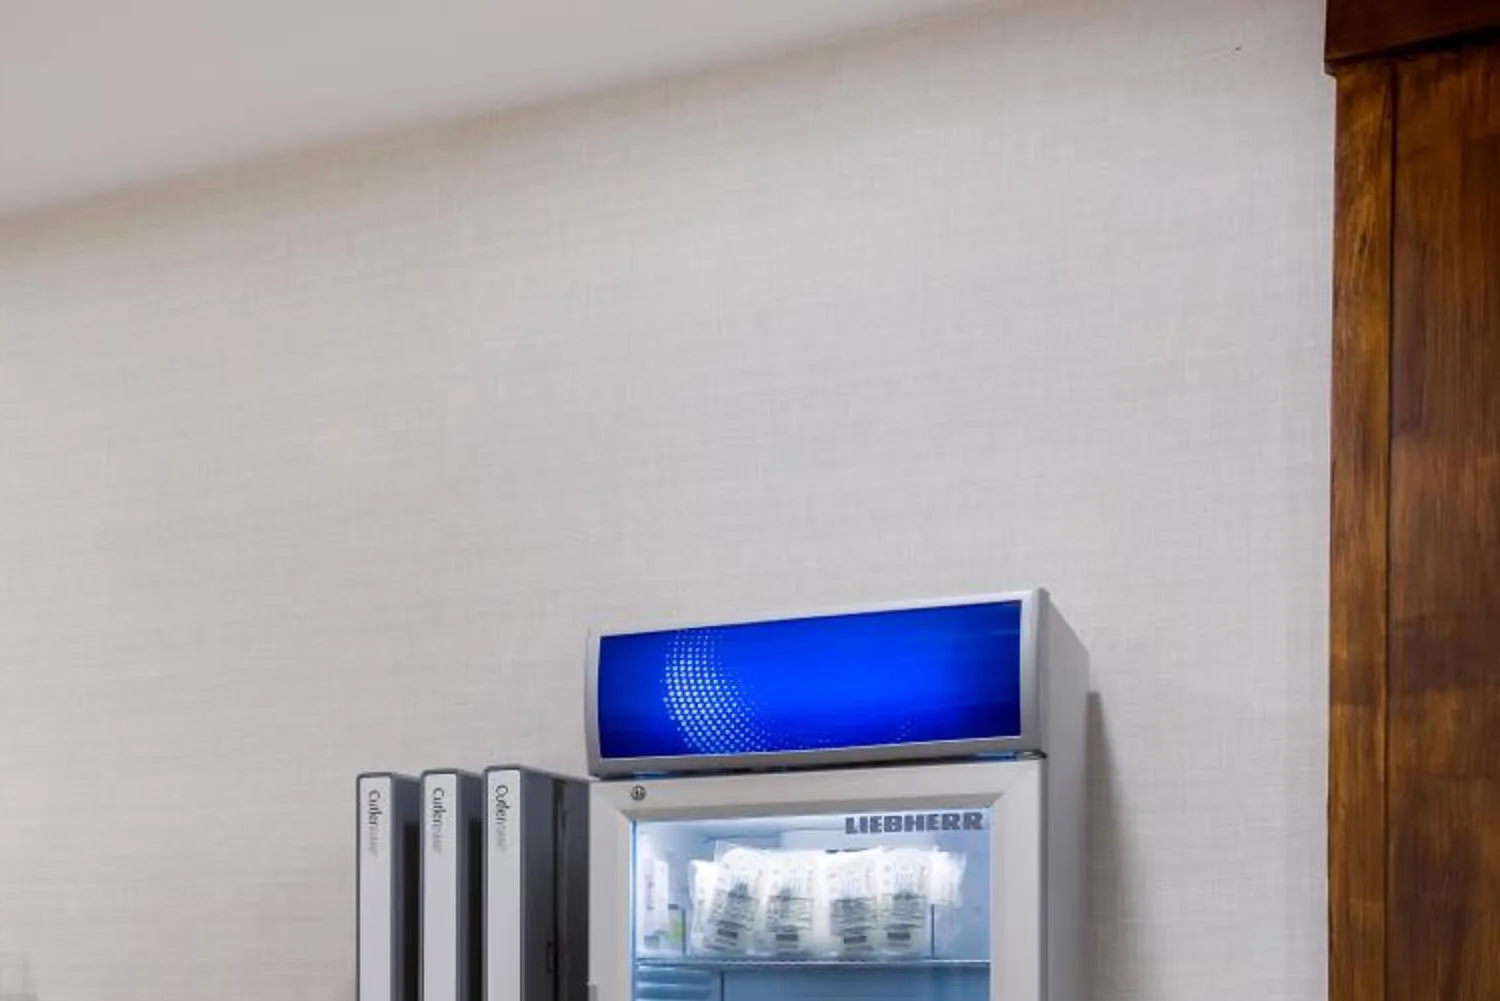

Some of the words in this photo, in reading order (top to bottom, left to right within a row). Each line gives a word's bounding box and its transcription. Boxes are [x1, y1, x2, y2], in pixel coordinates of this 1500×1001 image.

[368, 789, 382, 857] Cutler
[432, 787, 446, 855] Cutler
[495, 784, 510, 852] Cutler
[845, 812, 983, 834] LIEBHERR
